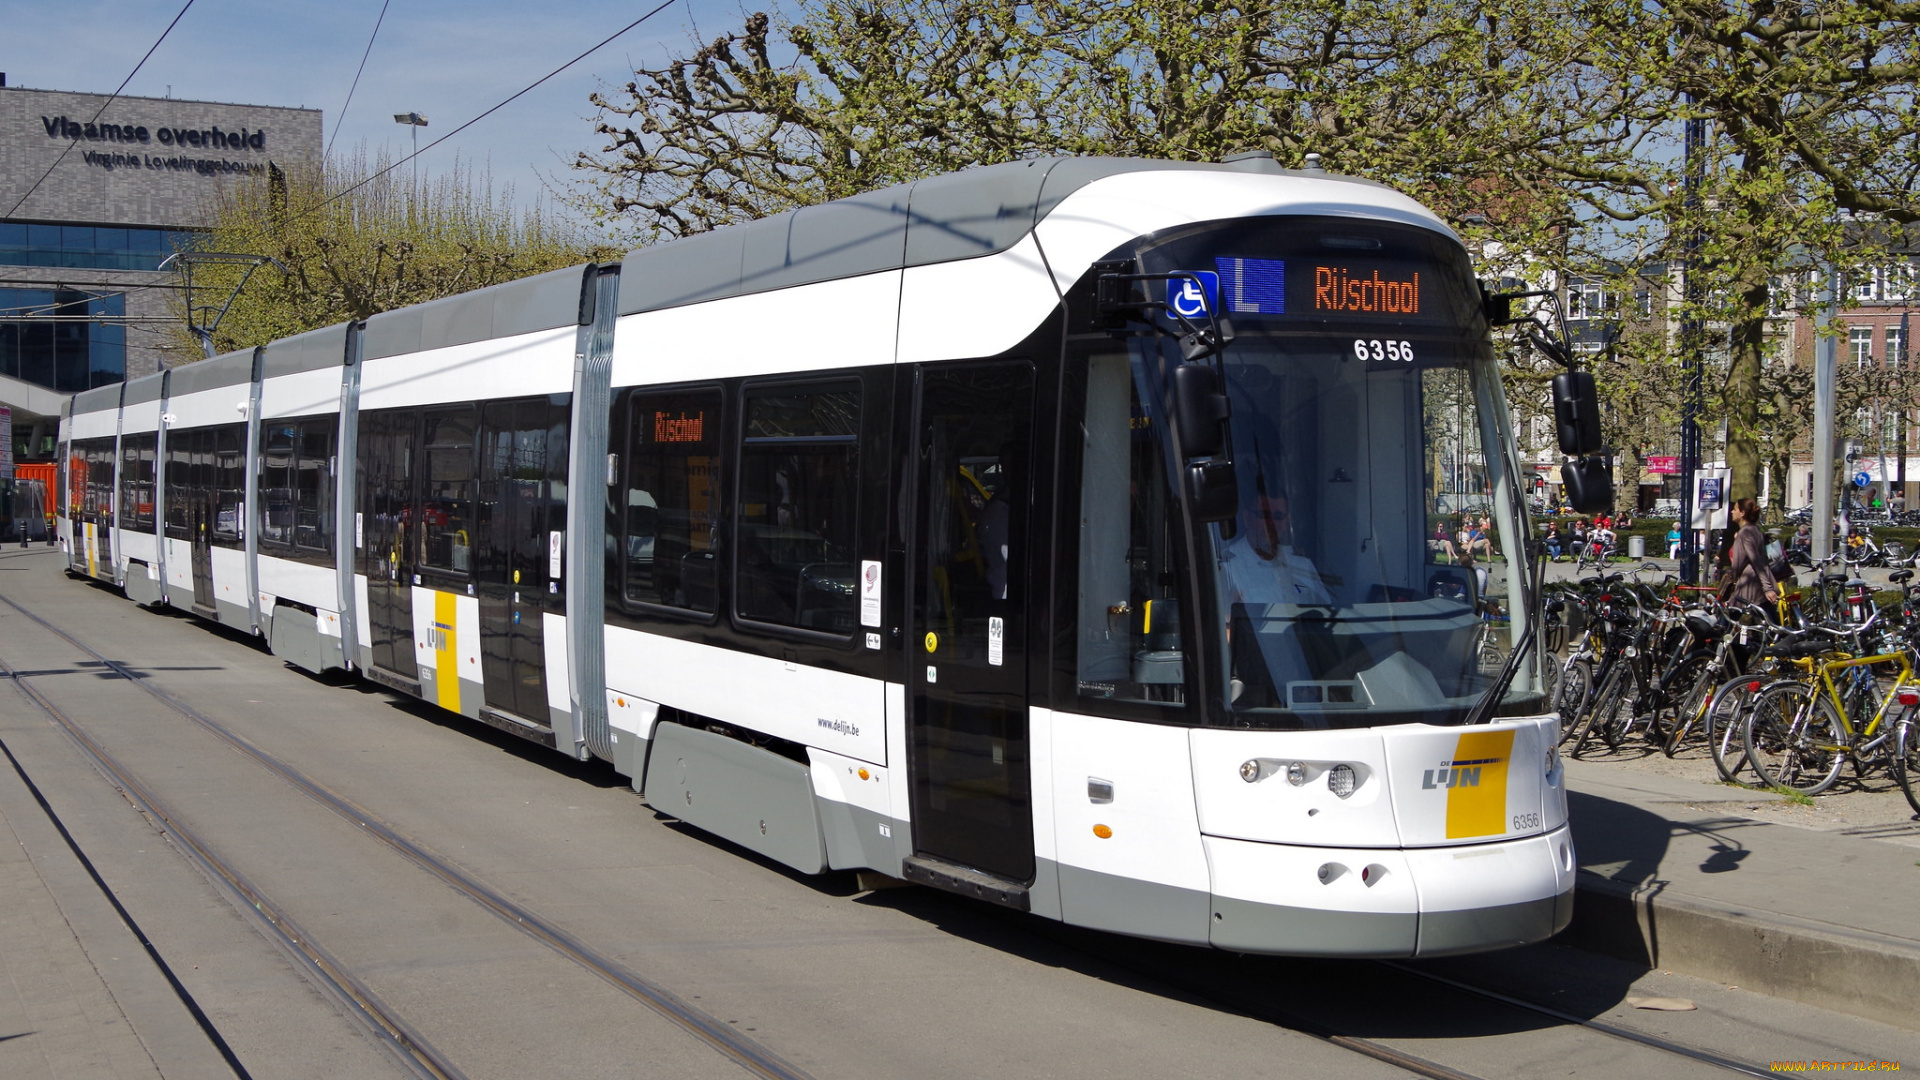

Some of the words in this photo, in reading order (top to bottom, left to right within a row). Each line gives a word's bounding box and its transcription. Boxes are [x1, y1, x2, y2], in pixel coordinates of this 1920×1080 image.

[41, 115, 149, 142] Vlaamse
[157, 126, 264, 149] overheid
[82, 150, 139, 168] Virginie
[144, 153, 264, 174] Lovelinggebouw
[1234, 258, 1260, 313] L
[1315, 266, 1419, 313] Rijschool
[1354, 339, 1414, 362] 6356
[655, 411, 703, 442] Rijschool
[817, 717, 860, 736] www.delijn.be
[1513, 812, 1540, 830] 6356
